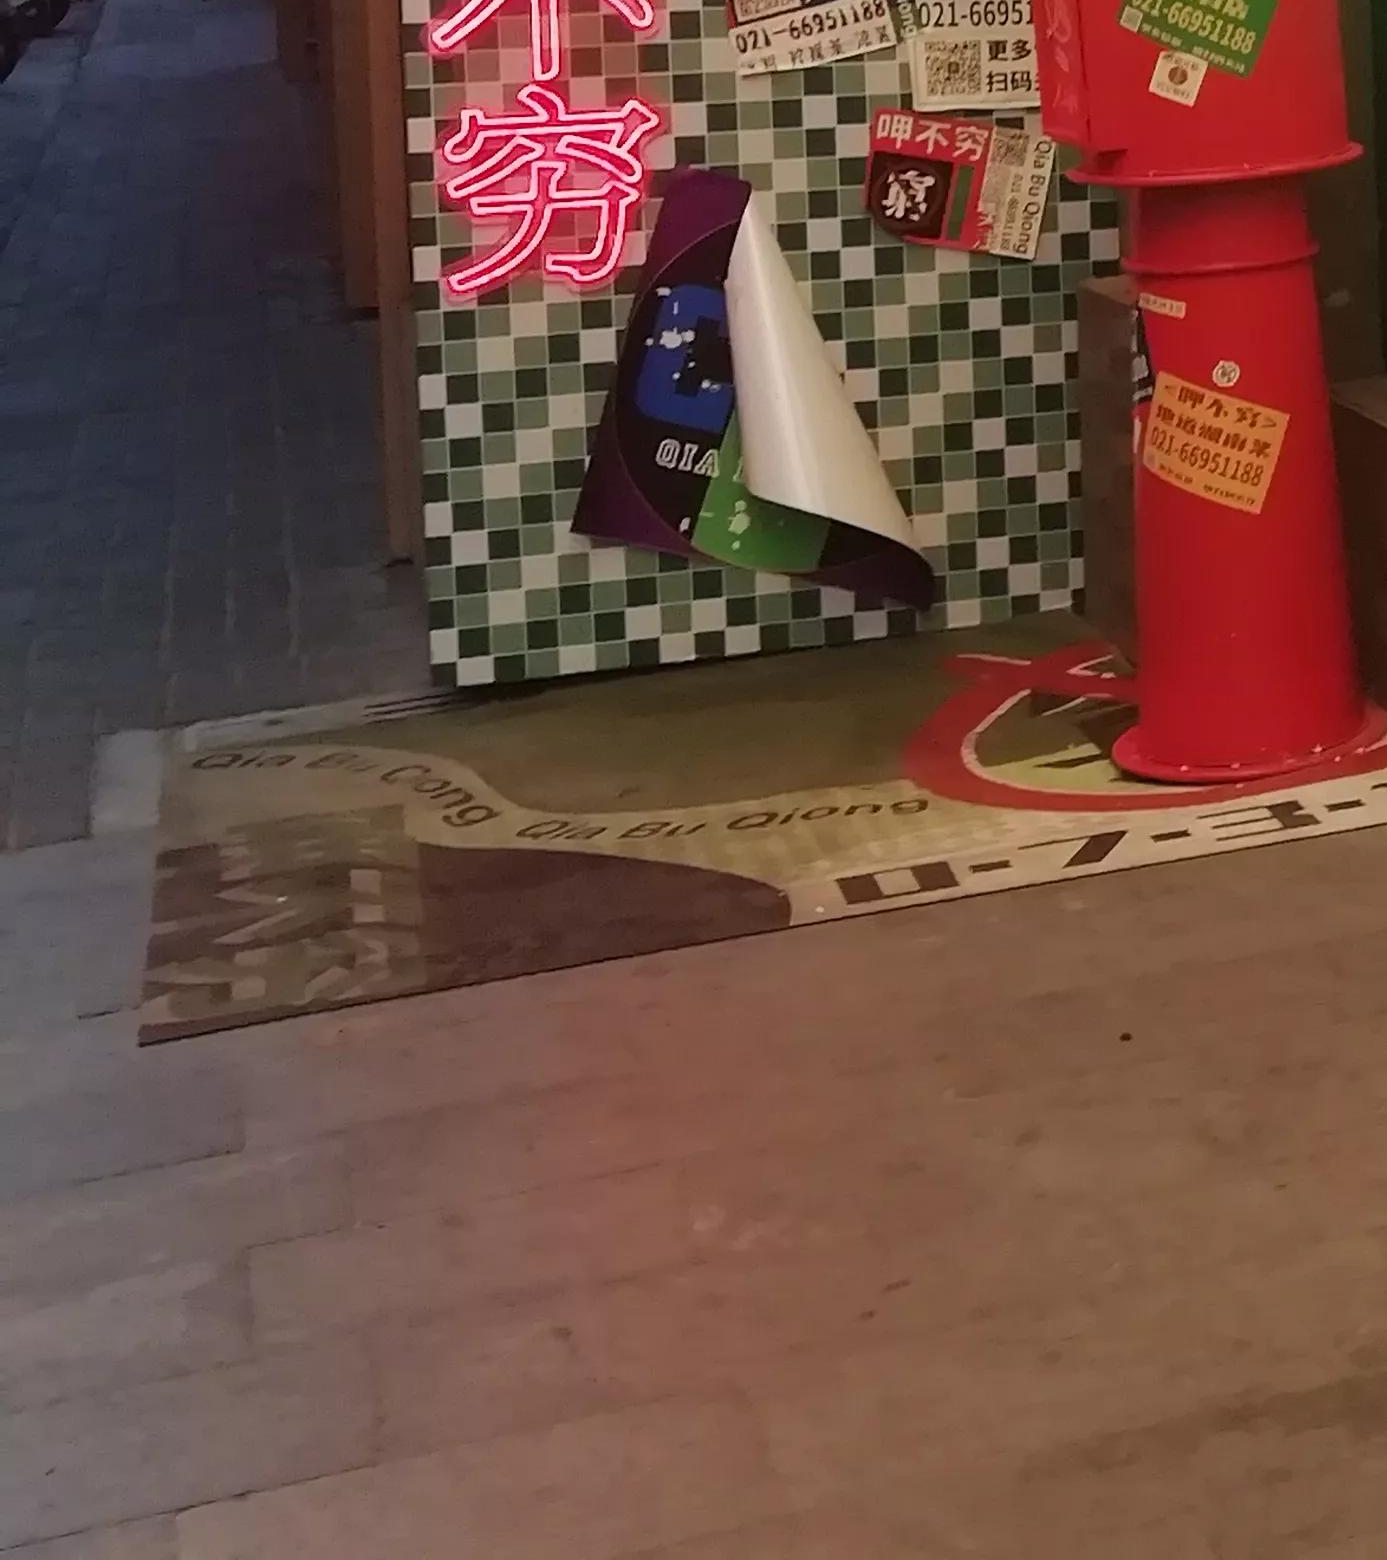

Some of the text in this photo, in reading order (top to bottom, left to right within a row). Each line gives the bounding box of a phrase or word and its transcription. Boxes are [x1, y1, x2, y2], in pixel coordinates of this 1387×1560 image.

[986, 69, 1040, 94] 扫码
[876, 113, 990, 162] 呷不穷
[655, 437, 719, 479] QIA
[1150, 425, 1265, 488] 021-66951188
[725, 796, 930, 833] Qiong
